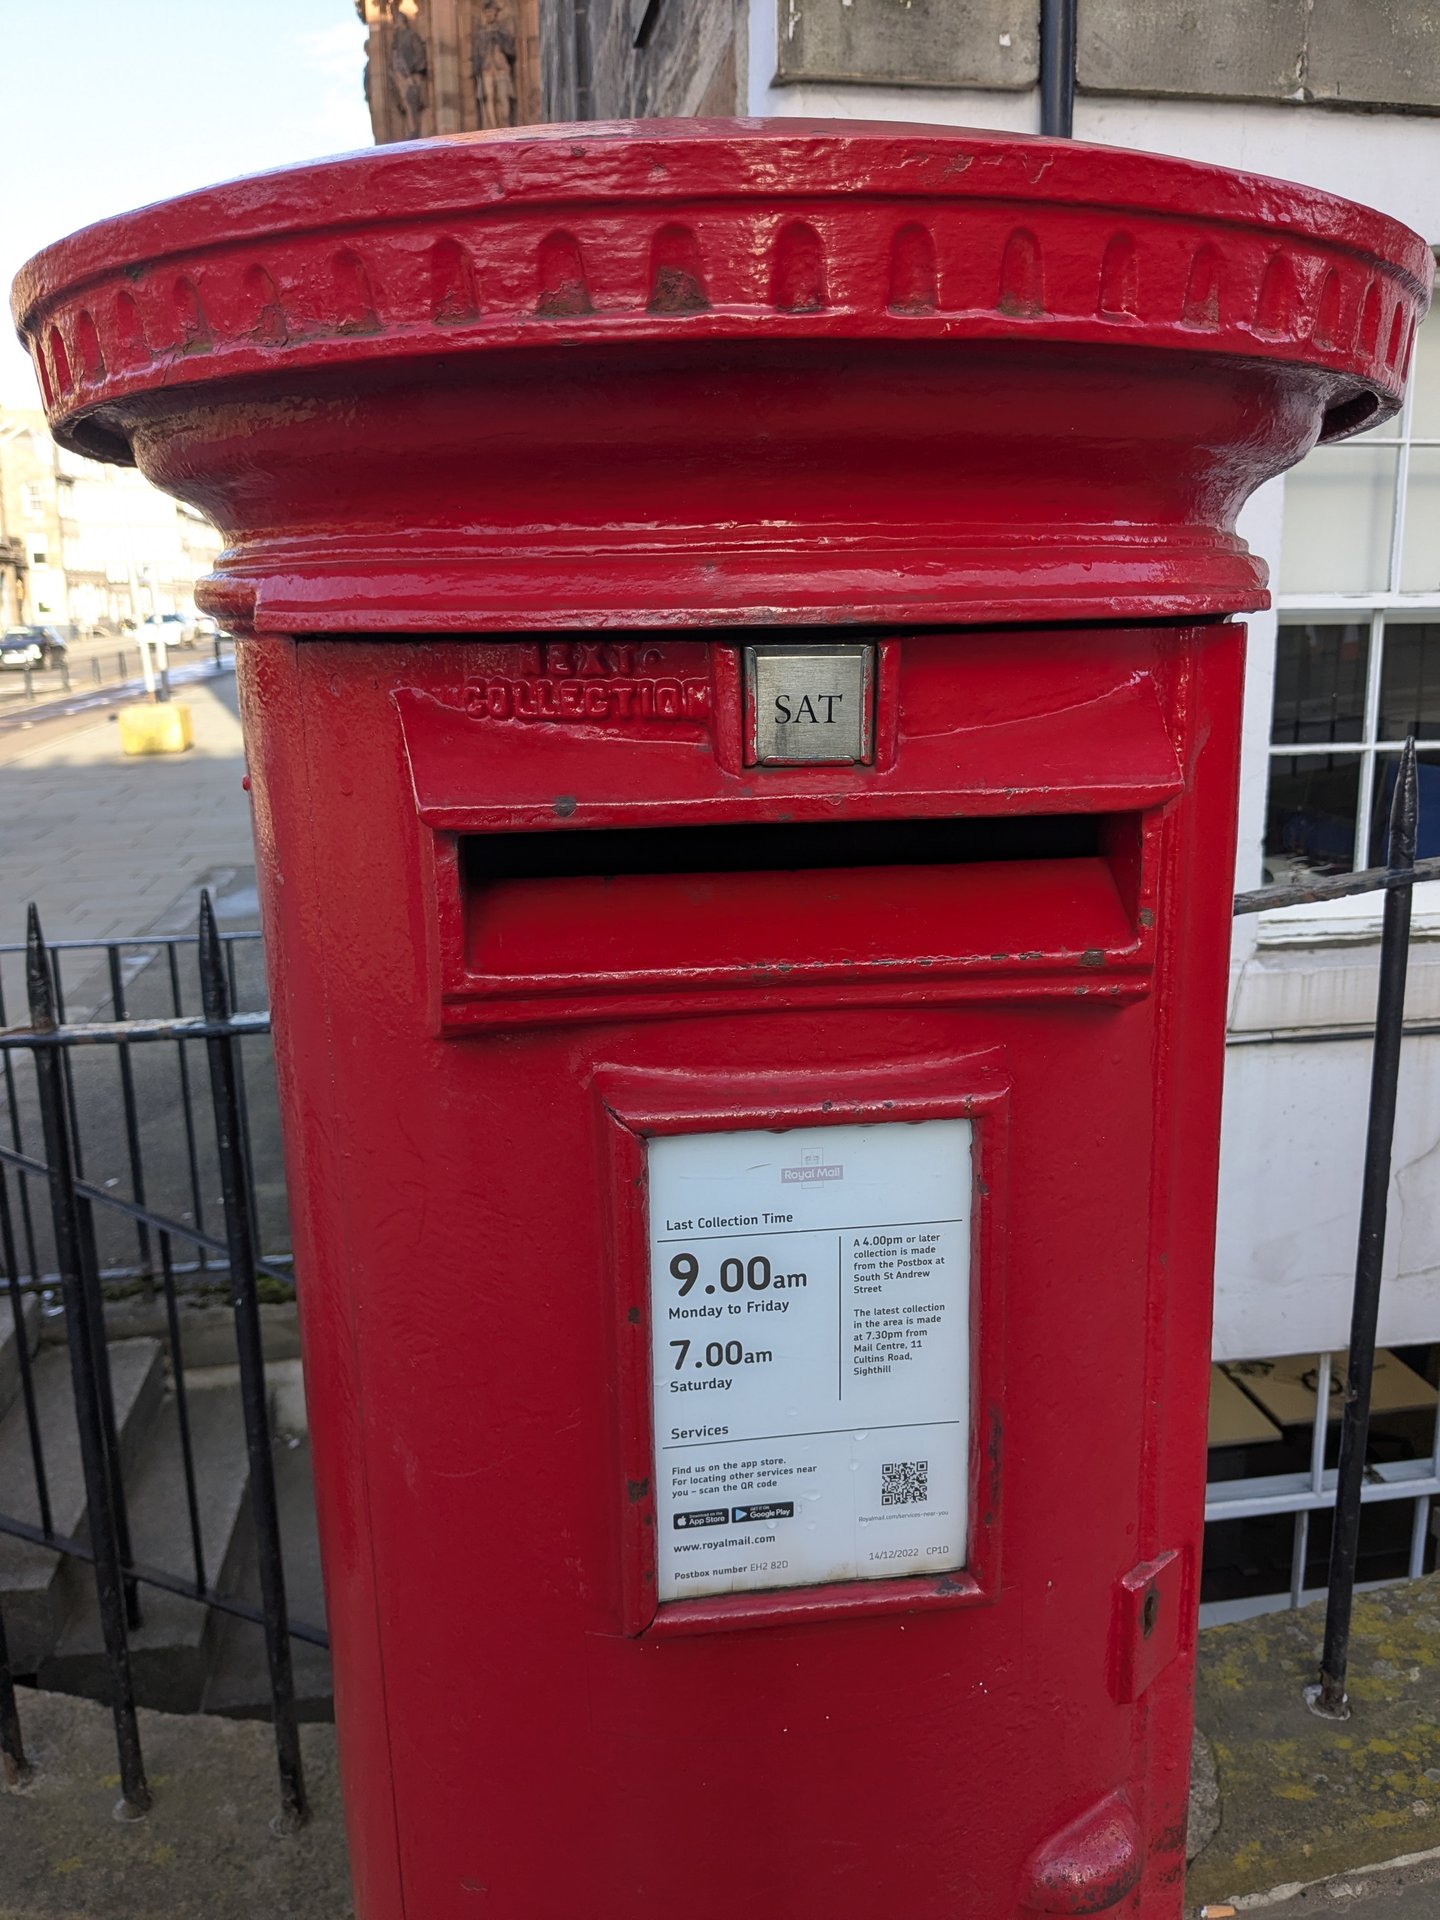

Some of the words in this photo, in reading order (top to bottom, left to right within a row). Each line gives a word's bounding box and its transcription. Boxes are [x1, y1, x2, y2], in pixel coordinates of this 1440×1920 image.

[464, 678, 711, 718] COLLECTION
[774, 693, 843, 725] SAT
[784, 1169, 815, 1180] Royal
[817, 1168, 840, 1177] Mail
[666, 1219, 694, 1231] Last
[697, 1214, 758, 1229] Collection
[762, 1212, 793, 1224] Time
[853, 1238, 860, 1247] A
[862, 1235, 903, 1246] 4.00pm
[919, 1234, 941, 1243] later
[853, 1249, 897, 1259] collection
[900, 1247, 908, 1255] is
[911, 1246, 936, 1254] made
[853, 1262, 876, 1270] from
[879, 1260, 894, 1269] the
[897, 1258, 933, 1268] Postbox
[935, 1256, 945, 1265] at
[669, 1252, 807, 1297] 9.00am
[853, 1273, 881, 1282] South
[883, 1272, 894, 1280] St
[896, 1270, 930, 1279] Andrew
[853, 1285, 882, 1294] Street
[668, 1306, 722, 1320] Monday
[727, 1303, 742, 1315] to
[747, 1300, 790, 1314] Friday
[853, 1308, 871, 1317] The
[874, 1306, 900, 1316] latest
[902, 1303, 945, 1313] collection
[853, 1320, 862, 1329] in
[865, 1318, 880, 1328] the
[906, 1316, 914, 1324] is
[917, 1315, 942, 1324] made
[853, 1333, 863, 1341] at
[865, 1330, 903, 1341] 7.30pm
[906, 1328, 928, 1337] from
[853, 1343, 873, 1353] Mail
[876, 1342, 908, 1351] Centre,
[911, 1340, 922, 1348] 11
[669, 1340, 773, 1370] 7.00am
[853, 1355, 885, 1364] Cultins
[887, 1353, 913, 1362] Road,
[853, 1365, 892, 1376] Sighthill
[670, 1377, 733, 1393] Saturday
[671, 1425, 729, 1440] Services
[672, 1466, 692, 1475] Find
[694, 1465, 706, 1473] us
[723, 1461, 738, 1470] the
[741, 1460, 758, 1469] app
[760, 1457, 786, 1466] store.
[672, 1477, 687, 1486] For
[690, 1473, 727, 1484] locating
[729, 1471, 754, 1480] other
[756, 1467, 794, 1478] services
[796, 1465, 817, 1474] near
[671, 1489, 689, 1499] you
[699, 1486, 720, 1495] scan
[723, 1484, 738, 1492] the
[741, 1481, 754, 1490] QR
[756, 1479, 777, 1488] code
[750, 1510, 775, 1518] Google
[776, 1508, 791, 1517] Play
[688, 1518, 704, 1526] App
[673, 1535, 776, 1553] www.royalmail.com
[868, 1548, 919, 1560] 14/12/2022
[674, 1567, 710, 1580] Postbox
[712, 1564, 748, 1576] number
[750, 1561, 768, 1572] EH2
[770, 1560, 789, 1569] 82D
